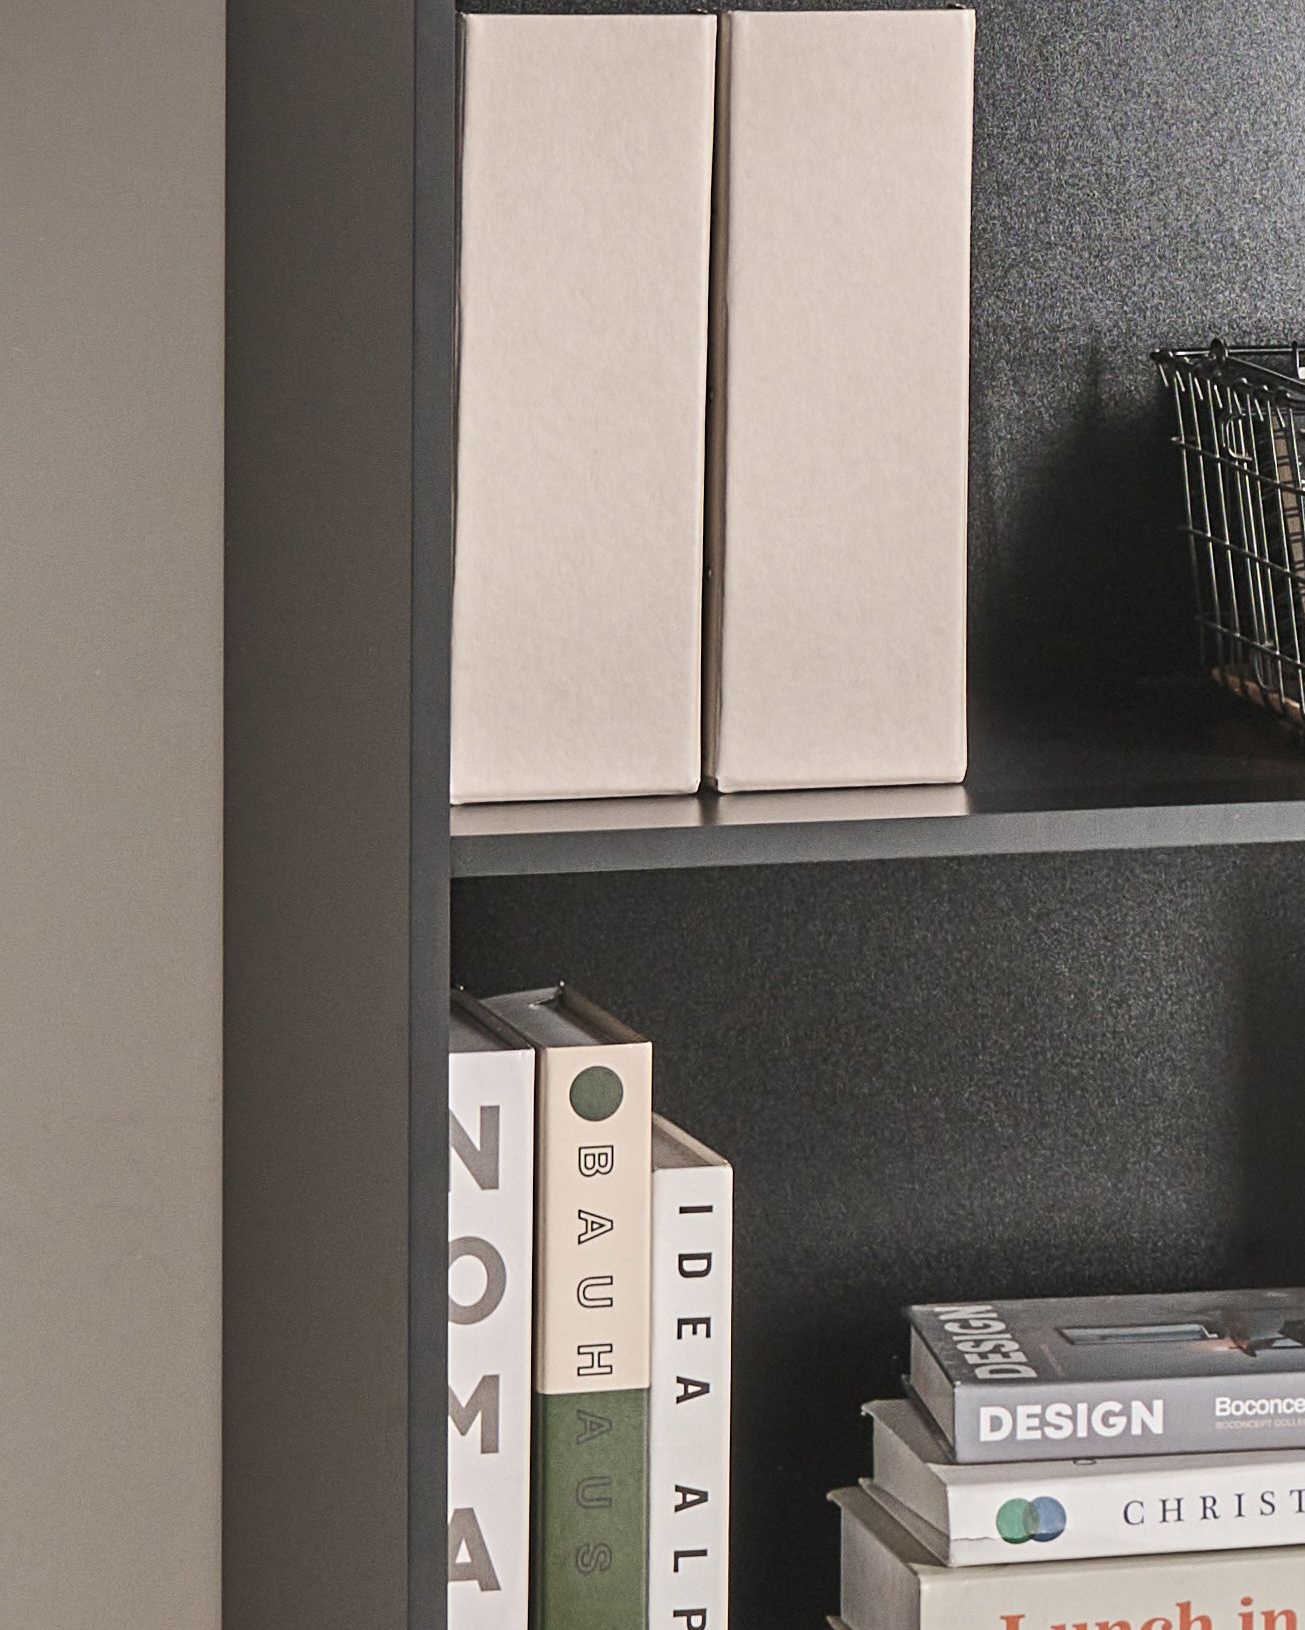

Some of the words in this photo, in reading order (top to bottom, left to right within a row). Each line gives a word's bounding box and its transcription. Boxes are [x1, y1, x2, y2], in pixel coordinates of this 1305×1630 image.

[575, 1143, 614, 1576] BAUHAUS
[676, 1204, 713, 1404] IDEA
[934, 1304, 1038, 1379] DESIGN
[979, 1400, 1164, 1441] DESIGN
